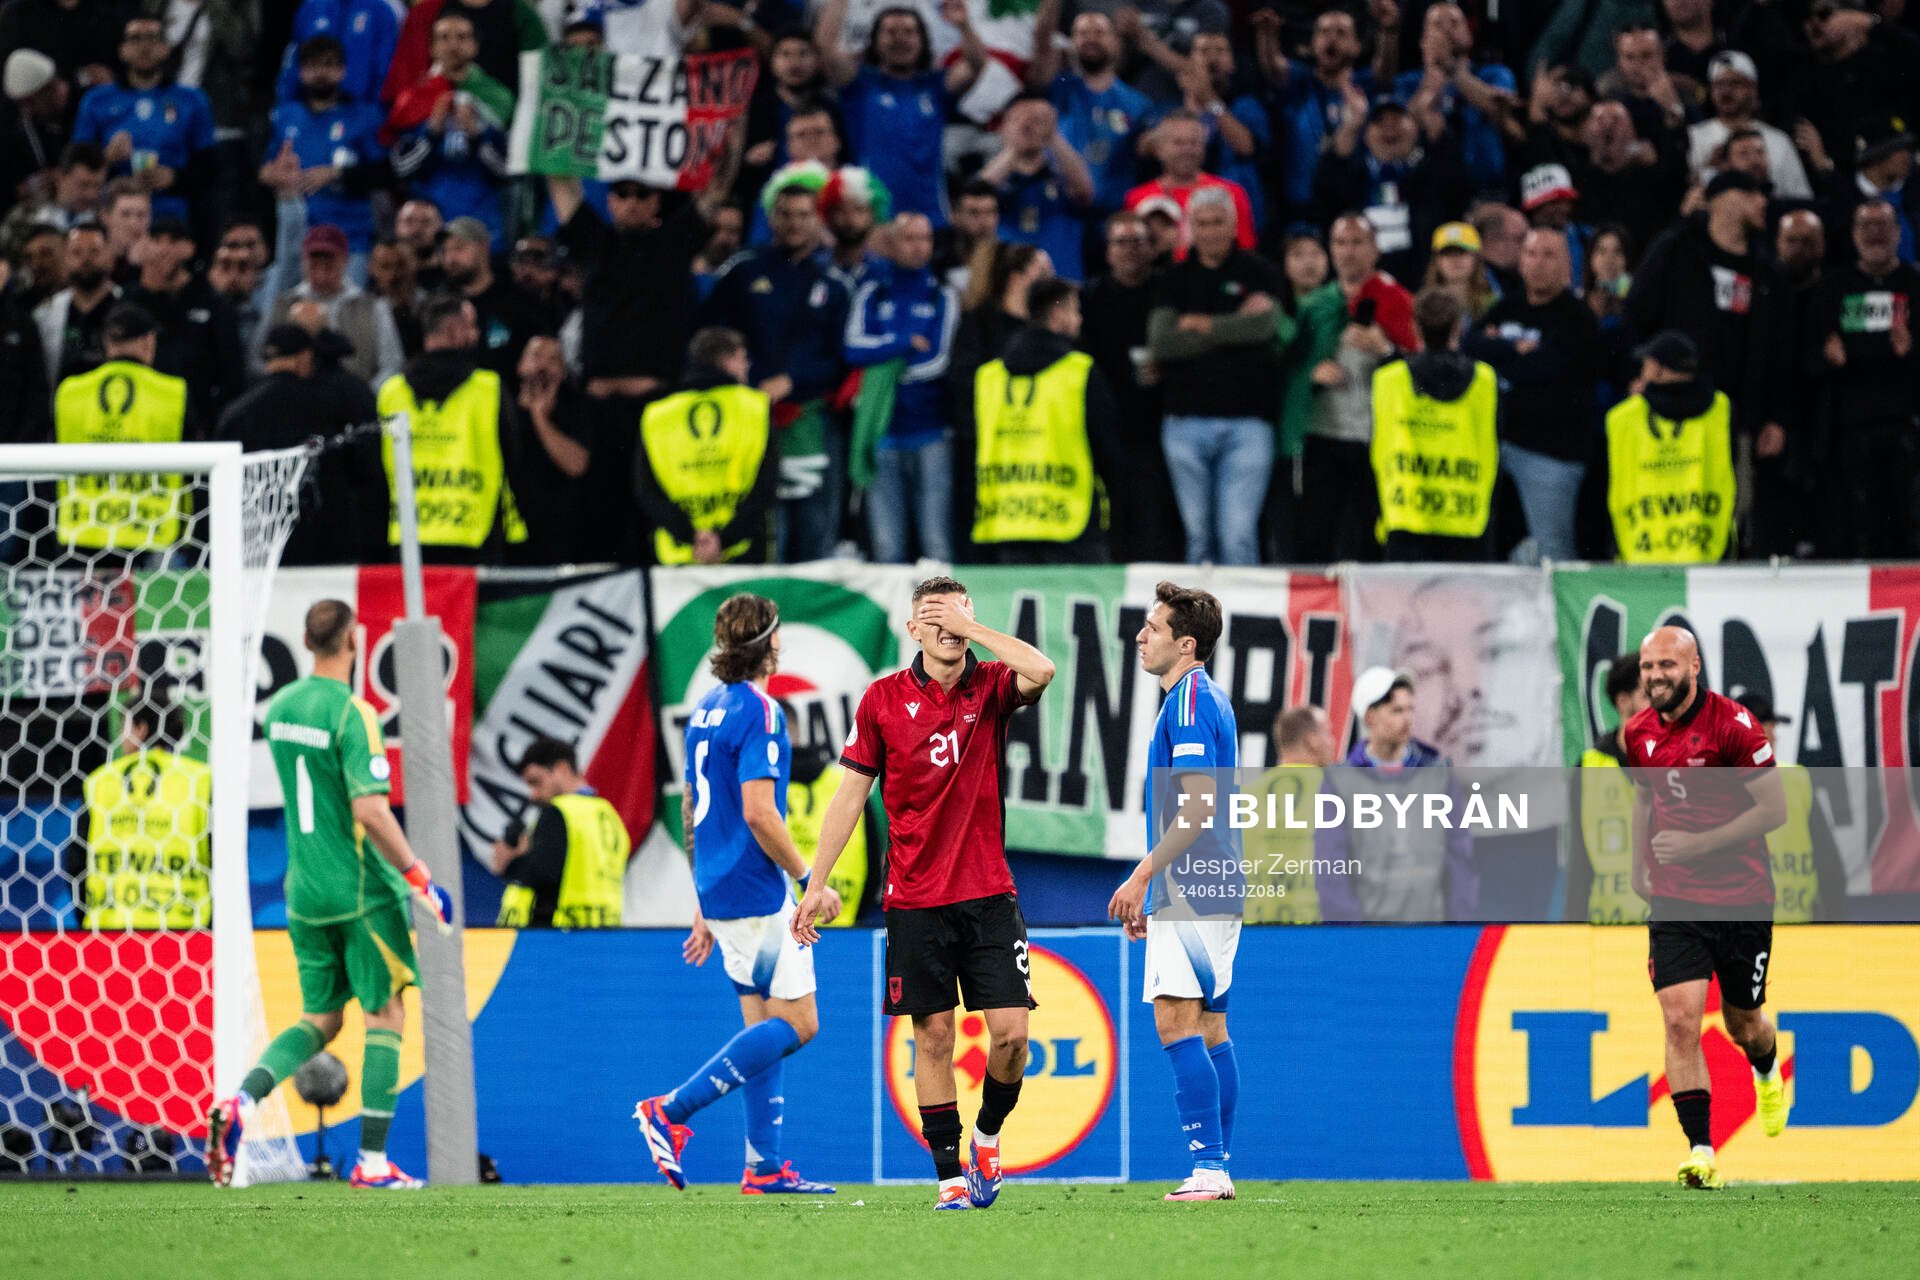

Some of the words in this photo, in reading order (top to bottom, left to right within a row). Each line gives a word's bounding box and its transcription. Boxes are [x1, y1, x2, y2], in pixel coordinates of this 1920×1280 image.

[0, 651, 128, 688] RECO
[1003, 597, 1338, 812] ANRI
[929, 730, 960, 768] 21
[295, 753, 315, 834] 1
